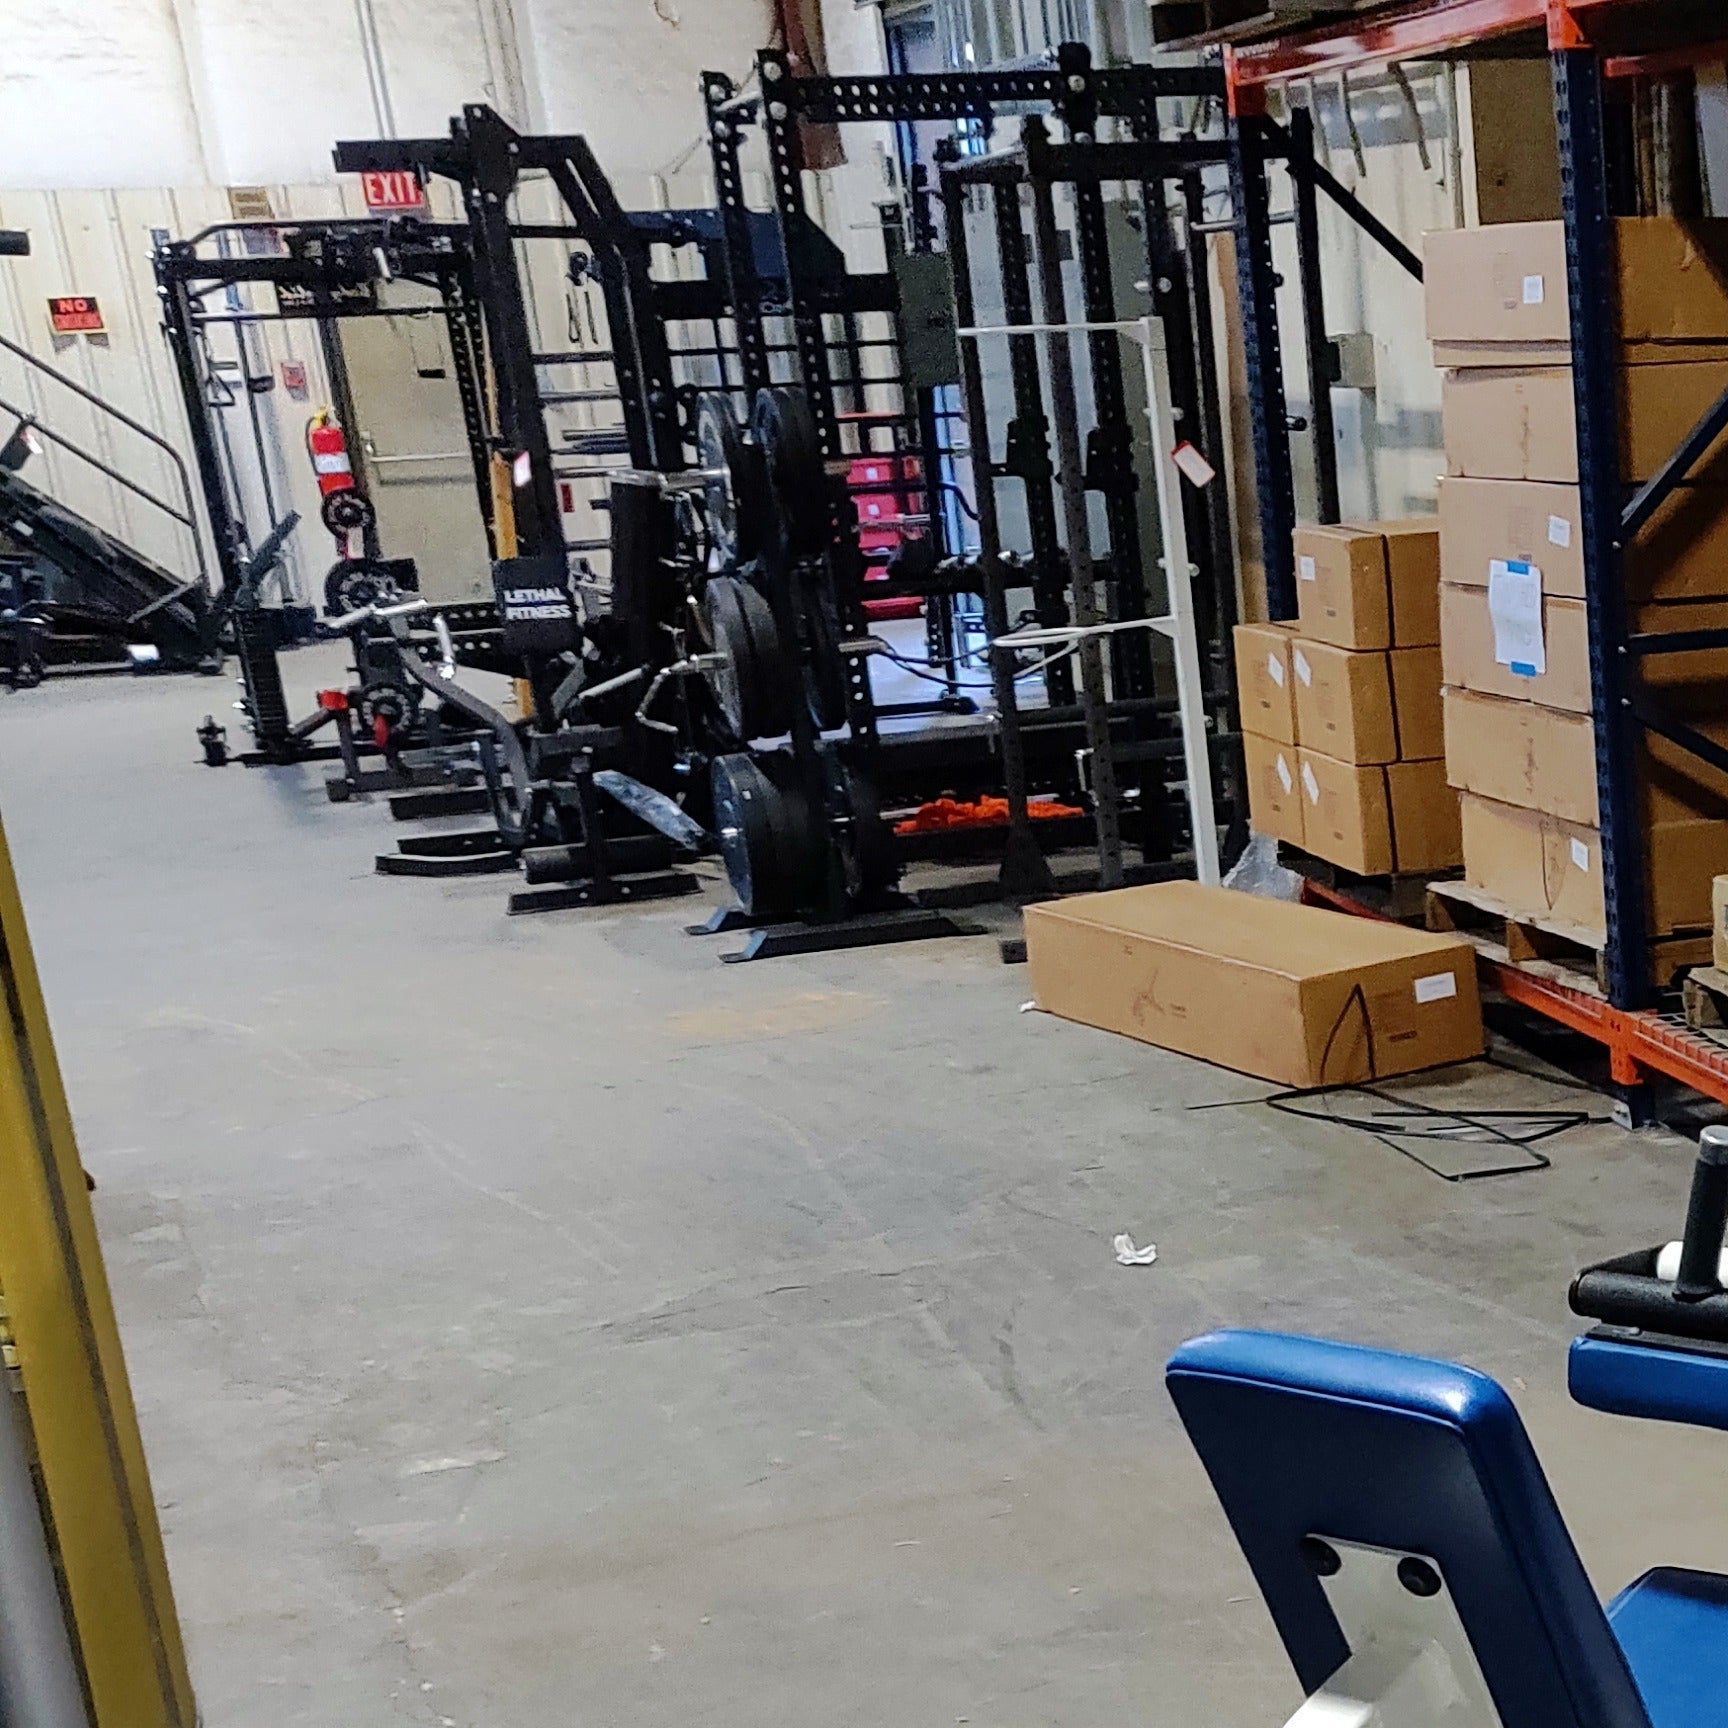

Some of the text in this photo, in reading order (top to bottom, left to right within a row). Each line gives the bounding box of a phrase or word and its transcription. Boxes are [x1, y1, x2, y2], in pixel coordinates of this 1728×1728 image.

[363, 171, 419, 205] EXIT
[58, 298, 88, 313] NO
[503, 586, 567, 603] LETHAL
[506, 604, 573, 620] FITNESS
